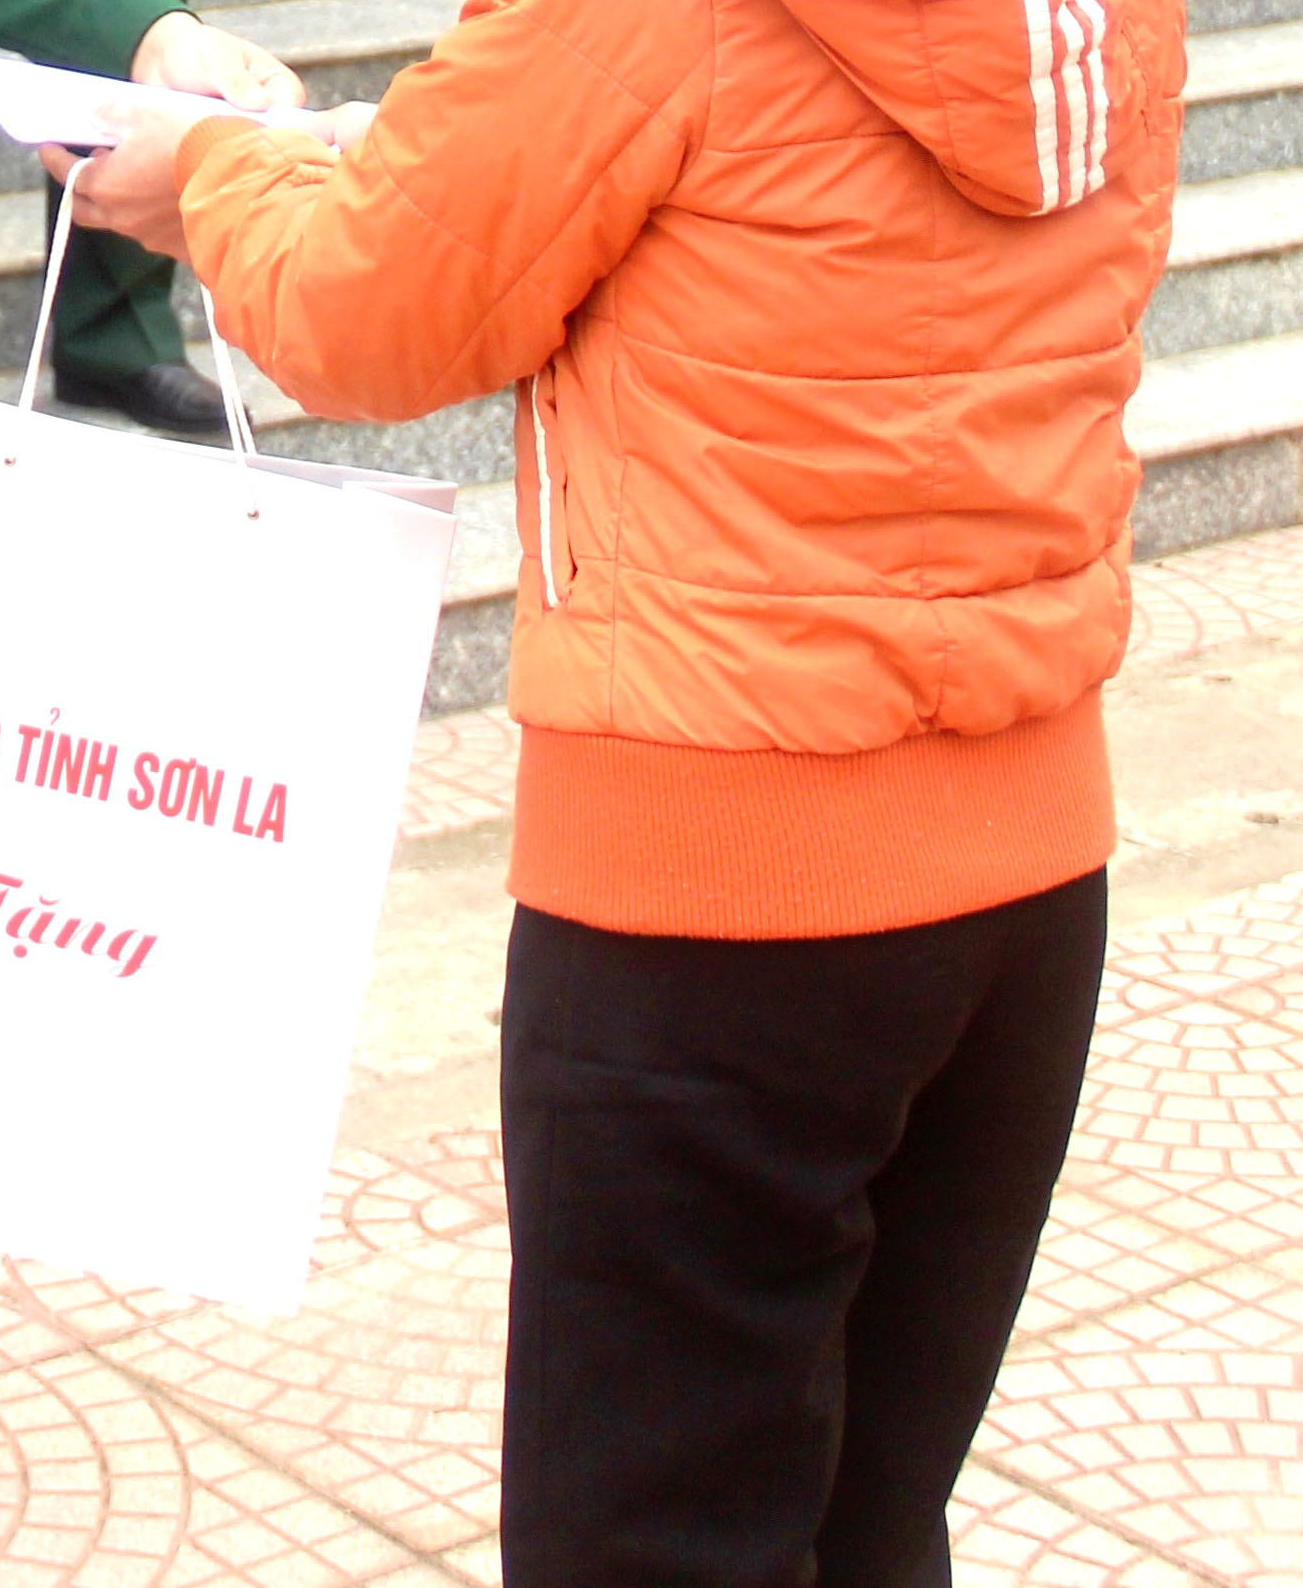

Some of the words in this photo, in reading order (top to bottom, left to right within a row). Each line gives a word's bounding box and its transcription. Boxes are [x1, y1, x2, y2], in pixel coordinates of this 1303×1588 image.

[15, 707, 118, 801] TỈNH
[127, 752, 224, 826] SƠN
[232, 776, 287, 843] LA
